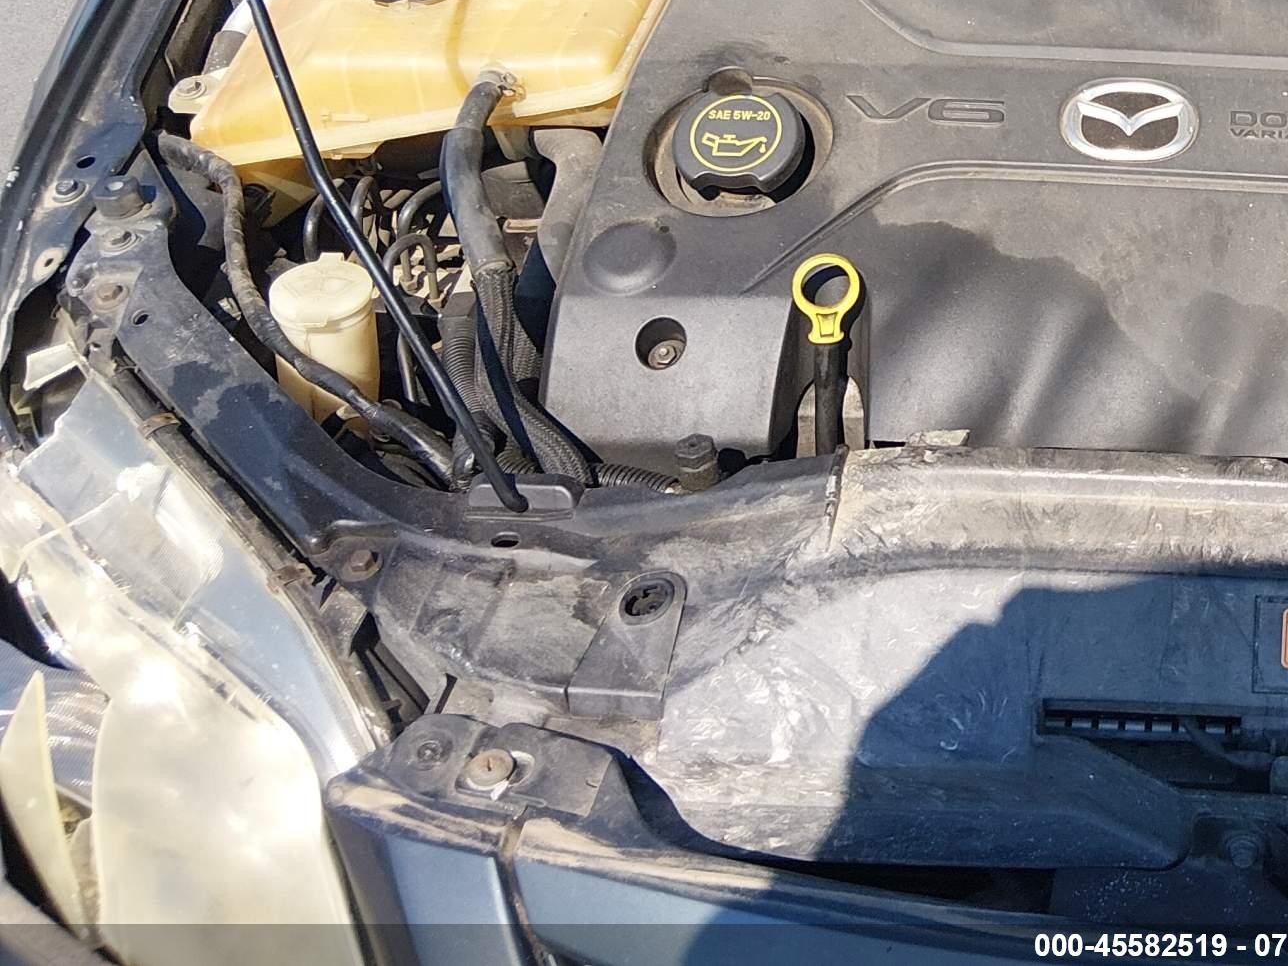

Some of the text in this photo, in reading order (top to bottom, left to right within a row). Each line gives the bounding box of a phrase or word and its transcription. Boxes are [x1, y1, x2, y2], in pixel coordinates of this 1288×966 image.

[708, 110, 771, 121] SAE 5W-20
[846, 94, 1005, 124] V6
